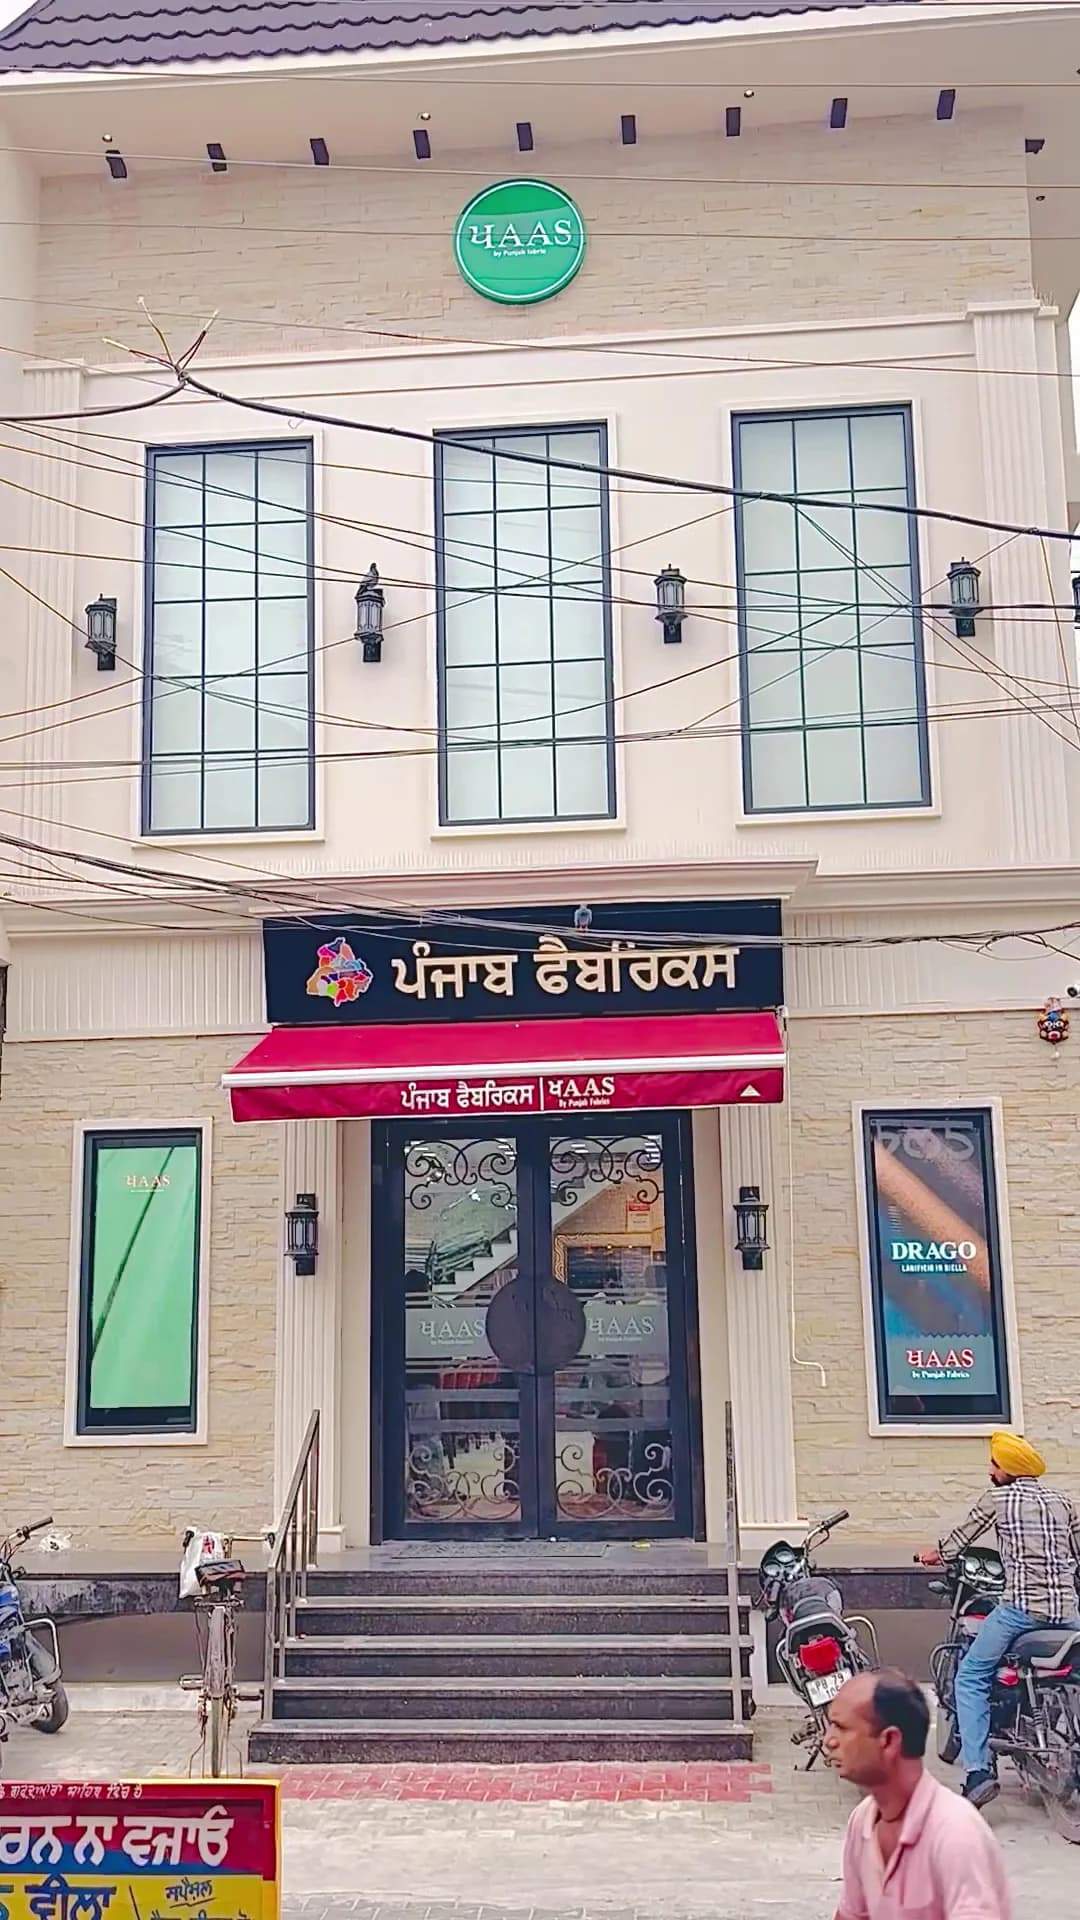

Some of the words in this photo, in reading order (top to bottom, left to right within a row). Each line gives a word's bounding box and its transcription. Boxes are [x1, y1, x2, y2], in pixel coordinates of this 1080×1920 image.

[391, 941, 518, 999] ਪੰਜਾਬ
[533, 934, 740, 994] ਫੈਬਰਿਕਸ
[400, 1082, 451, 1110] ਪੰਜਾਬ
[456, 1080, 535, 1108] ਫੈਬਰਿਕਸ
[891, 1241, 977, 1260] DRAGO
[815, 1679, 828, 1691] PB
[74, 1816, 118, 1866] ਨਾ
